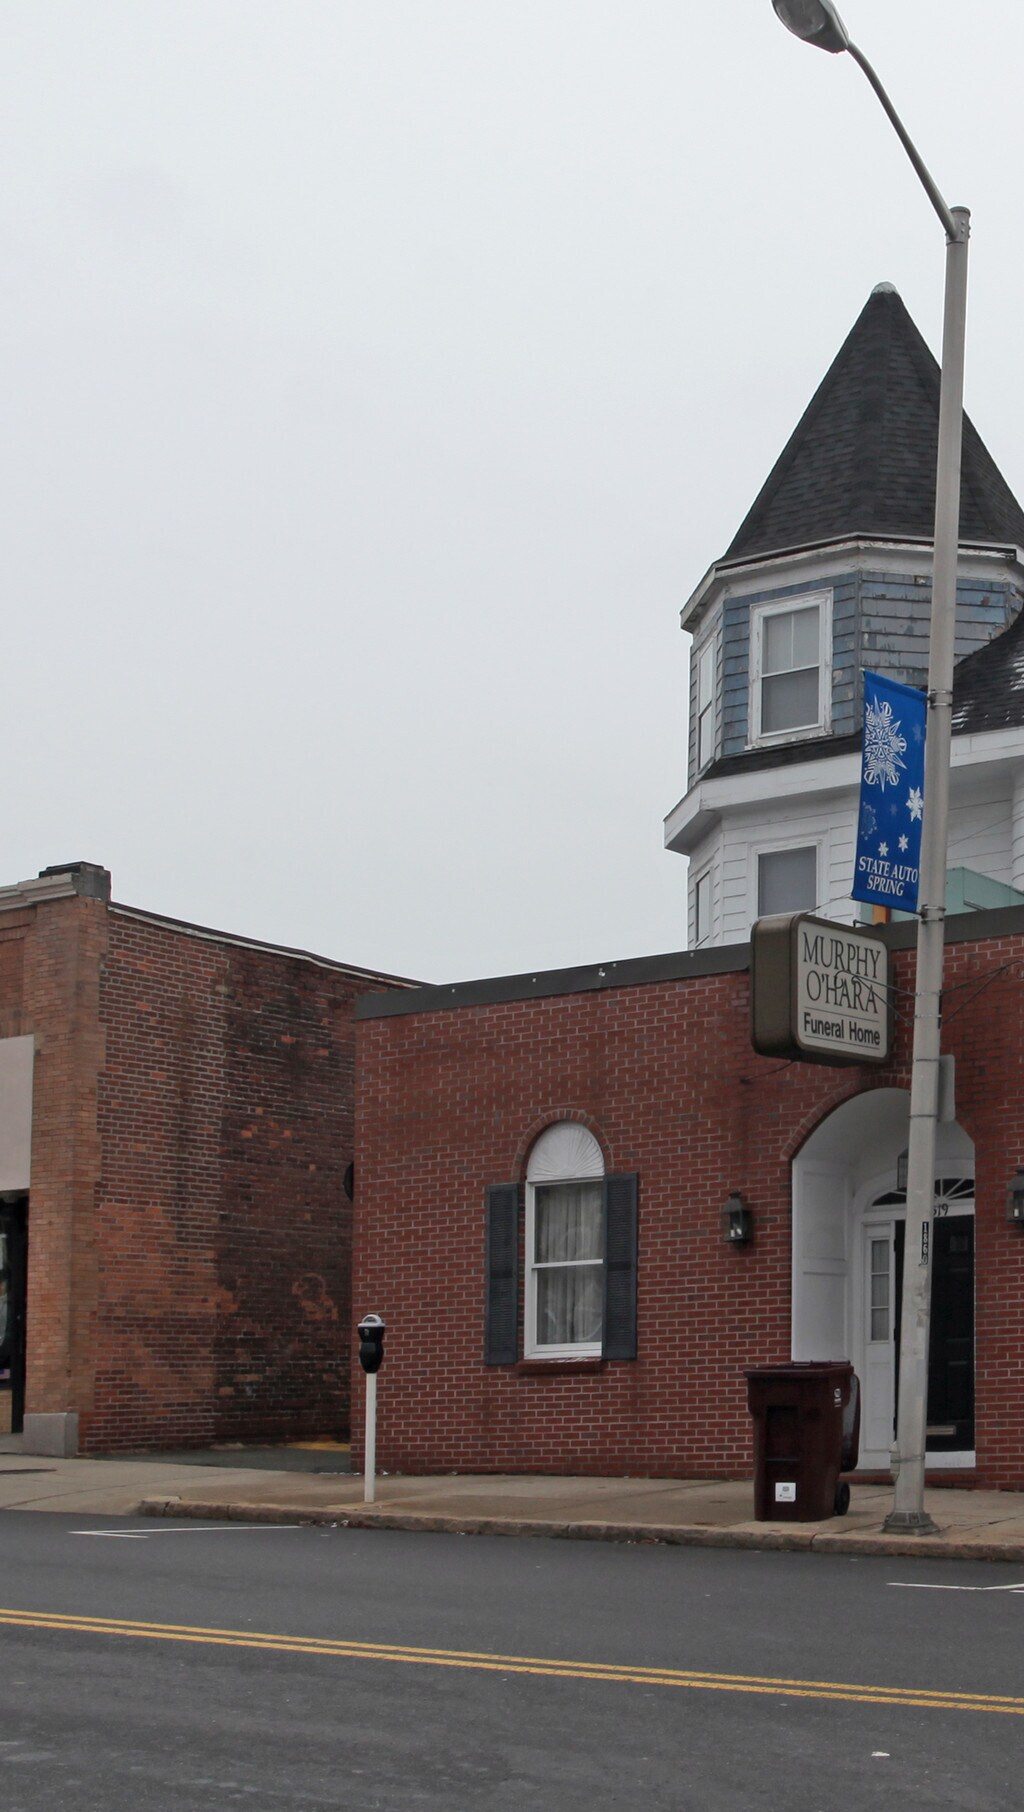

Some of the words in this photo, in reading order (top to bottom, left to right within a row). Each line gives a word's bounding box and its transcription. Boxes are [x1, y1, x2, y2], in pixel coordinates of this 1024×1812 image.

[858, 856, 890, 877] STATE
[891, 864, 918, 884] AUTO
[867, 875, 905, 896] SPRING
[803, 932, 880, 978] MURPHY
[806, 970, 878, 1014] O'HARA
[803, 1012, 845, 1038] Funeral
[849, 1021, 880, 1046] Home
